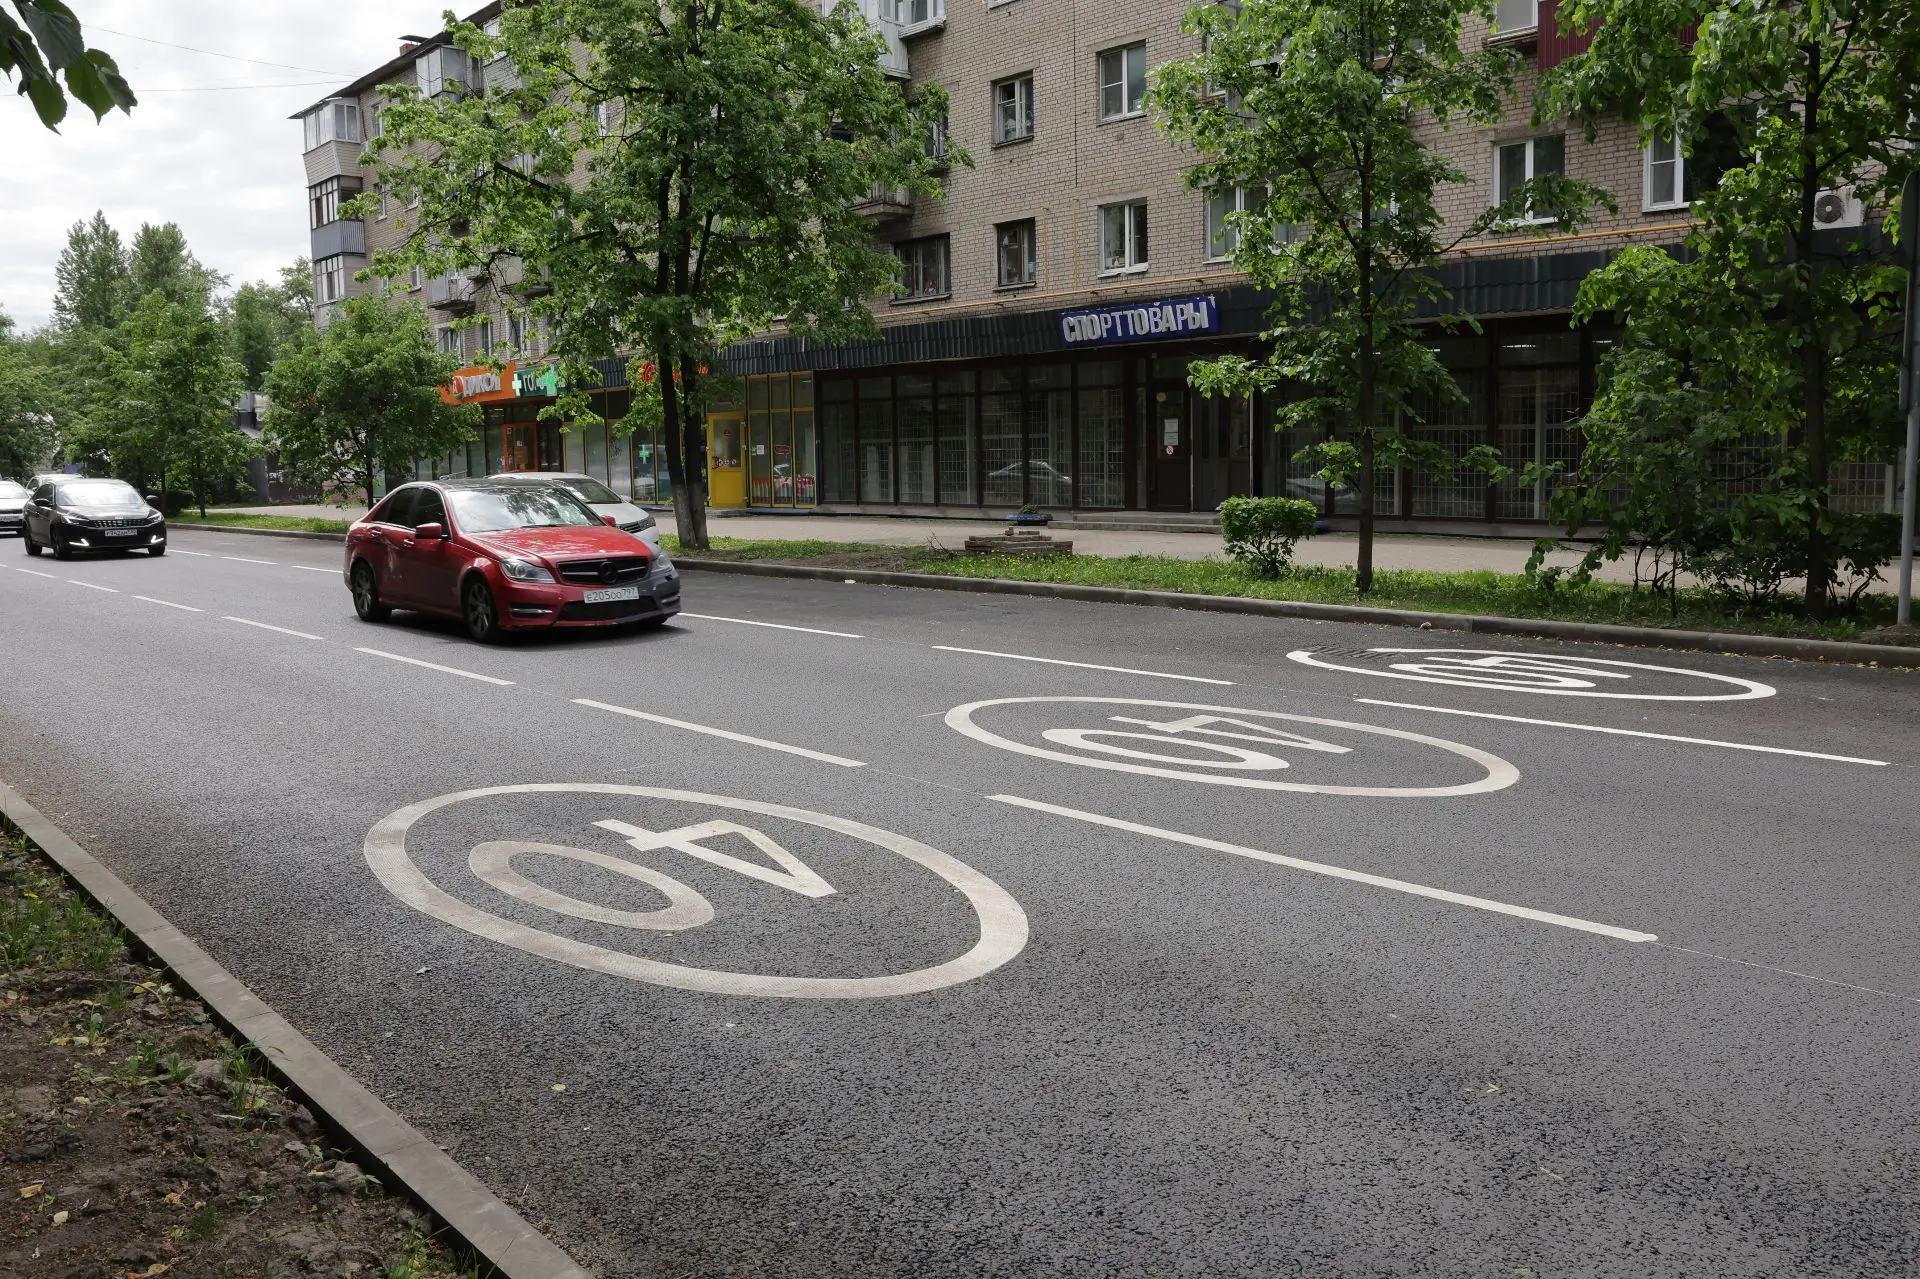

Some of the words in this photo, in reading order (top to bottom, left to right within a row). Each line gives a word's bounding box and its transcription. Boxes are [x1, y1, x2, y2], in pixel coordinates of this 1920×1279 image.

[1062, 301, 1209, 342] СПОРТТОВАРЫ
[1041, 715, 1355, 771] 40
[468, 818, 838, 931] 40
